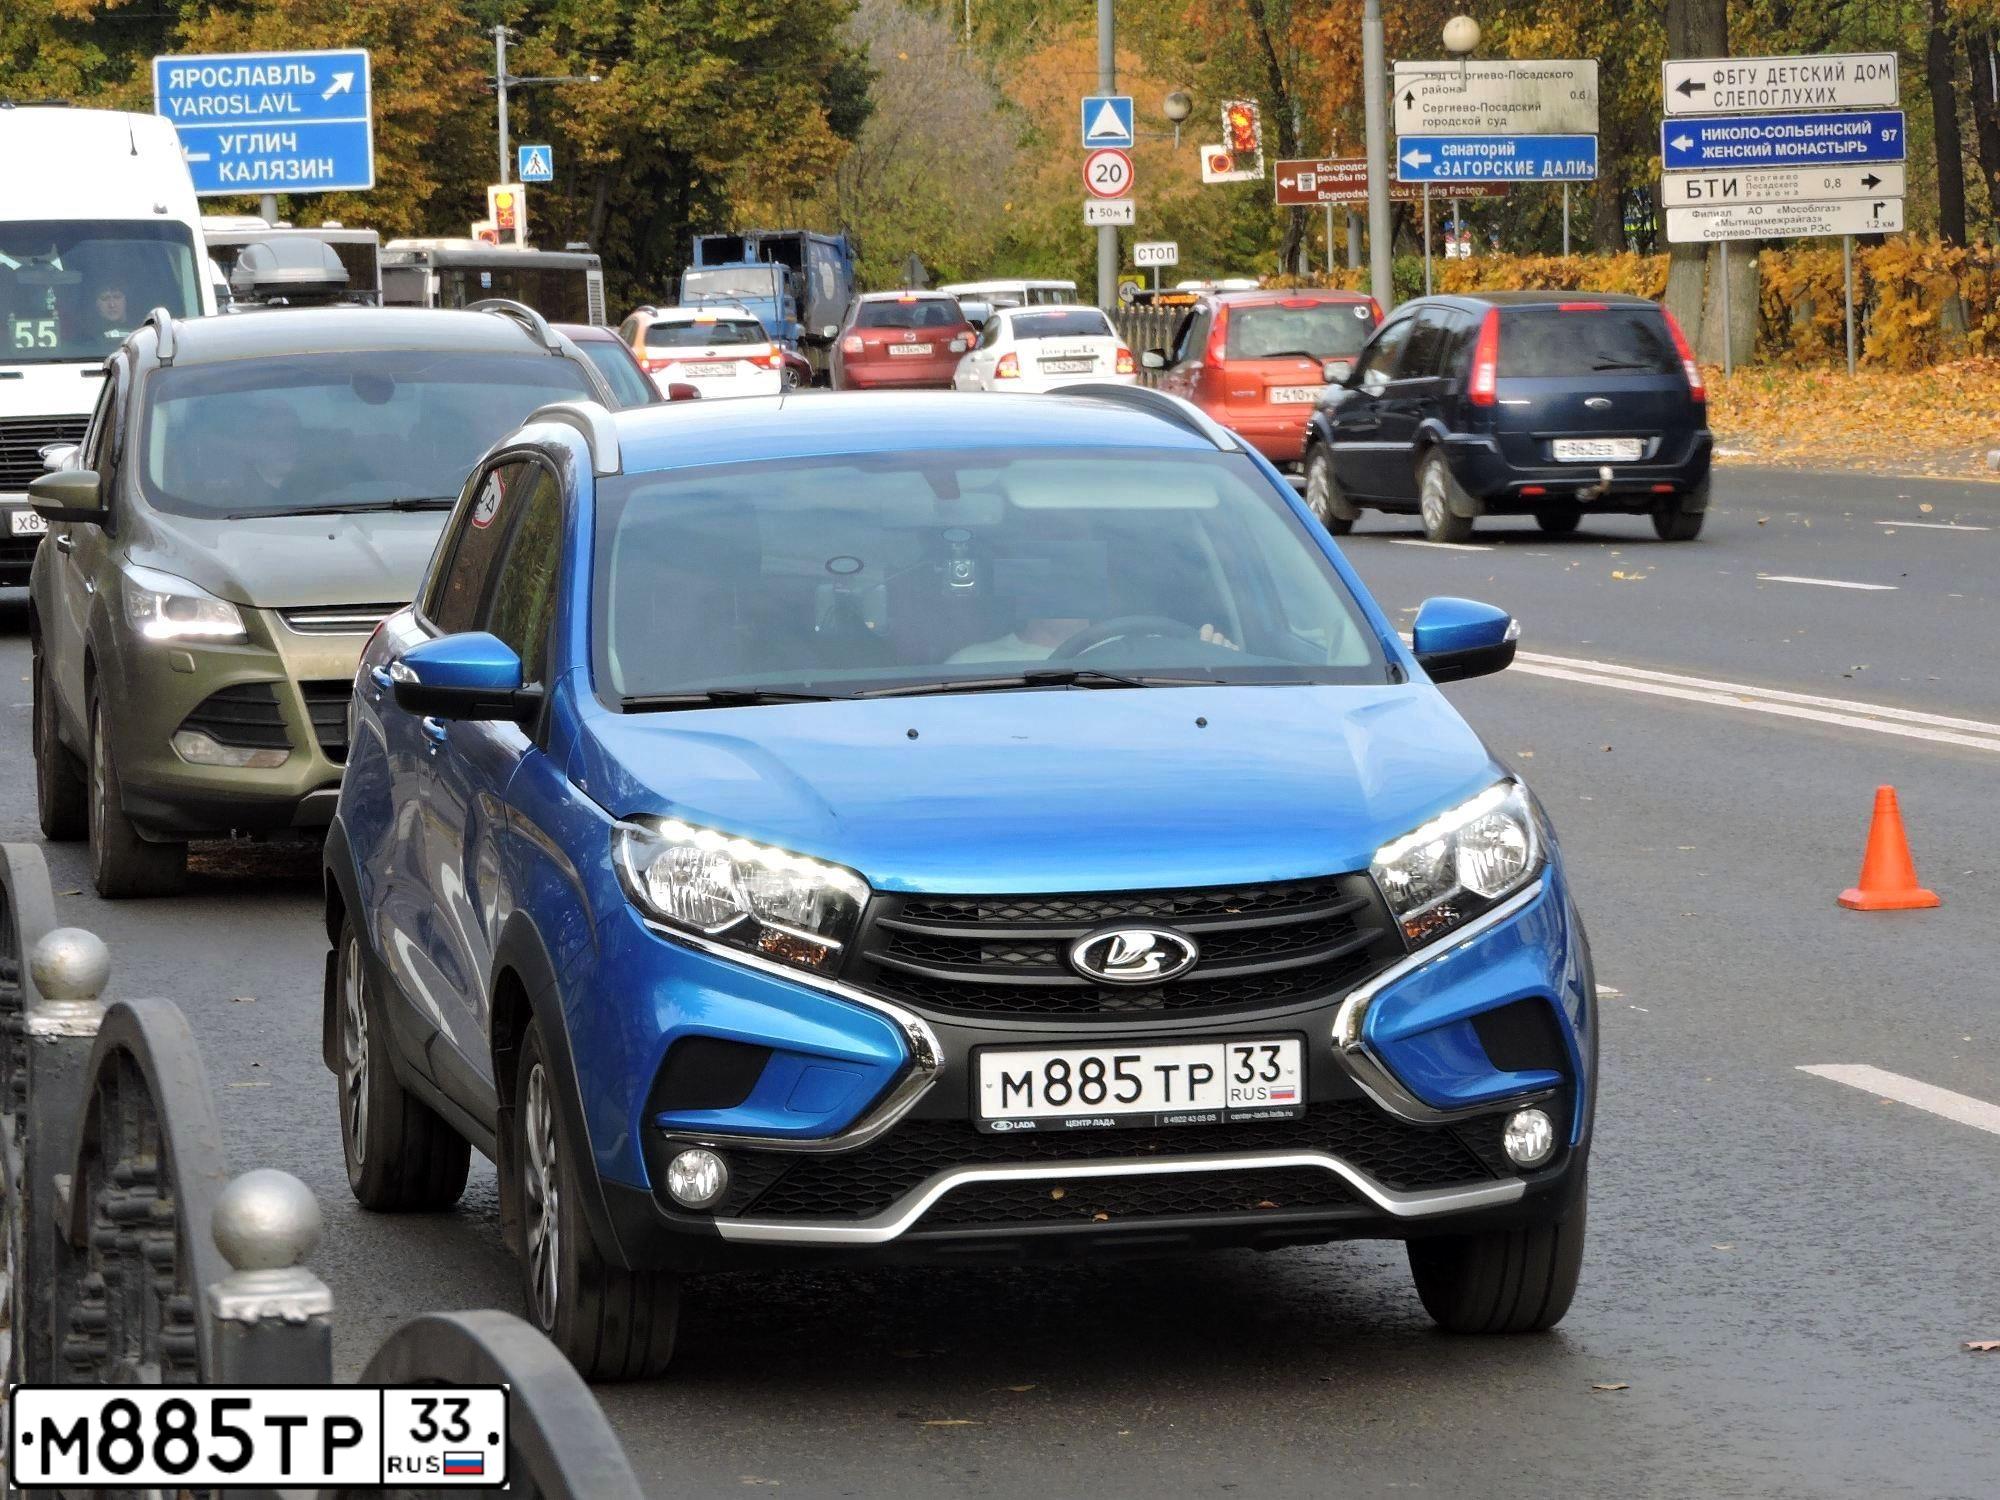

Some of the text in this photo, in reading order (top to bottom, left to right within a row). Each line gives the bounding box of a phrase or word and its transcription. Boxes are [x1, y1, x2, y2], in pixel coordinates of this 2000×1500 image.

[168, 64, 316, 89] ЯРОСЛАВЛЬ
[1450, 70, 1574, 81] Сргиево-Посадского
[1713, 62, 1890, 86] ФБГУ ДЕТСКИЙ ДОМ
[1421, 85, 1462, 96] района
[1714, 87, 1837, 107] СЛЕПОГЛУХИХ
[169, 93, 301, 116] YAROSLAVL
[1422, 102, 1542, 115] Сергиево-Посадский
[1422, 117, 1507, 127] городской суд
[1701, 120, 1897, 141] НИКОЛО-СОЛЬБИНСКИЙ 97
[218, 132, 297, 154] УГЛИЧ
[1441, 141, 1515, 159] санаторий
[1702, 141, 1868, 159] ЖЕНСКИЙ МОНАСТЫРЬ
[219, 158, 334, 182] КАЛЯЗИН
[1096, 164, 1122, 182] 20
[1433, 160, 1594, 178] «ЗАГОРСКИЕ ДАЛИ»
[1687, 178, 1738, 198] БТИ
[1692, 208, 1732, 219] Филиал
[1747, 206, 1763, 215] АО
[1703, 224, 1832, 239] Сергиево-Посадская РЭС
[1138, 247, 1175, 261] СТОП
[14, 321, 58, 349] 55
[1233, 1045, 1281, 1084] 33
[1001, 1055, 1214, 1109] М885ТР
[1230, 1087, 1267, 1101] RUS
[1014, 1121, 1036, 1129] LADA
[1065, 1118, 1116, 1128] ЦЕНТР ЛАДА
